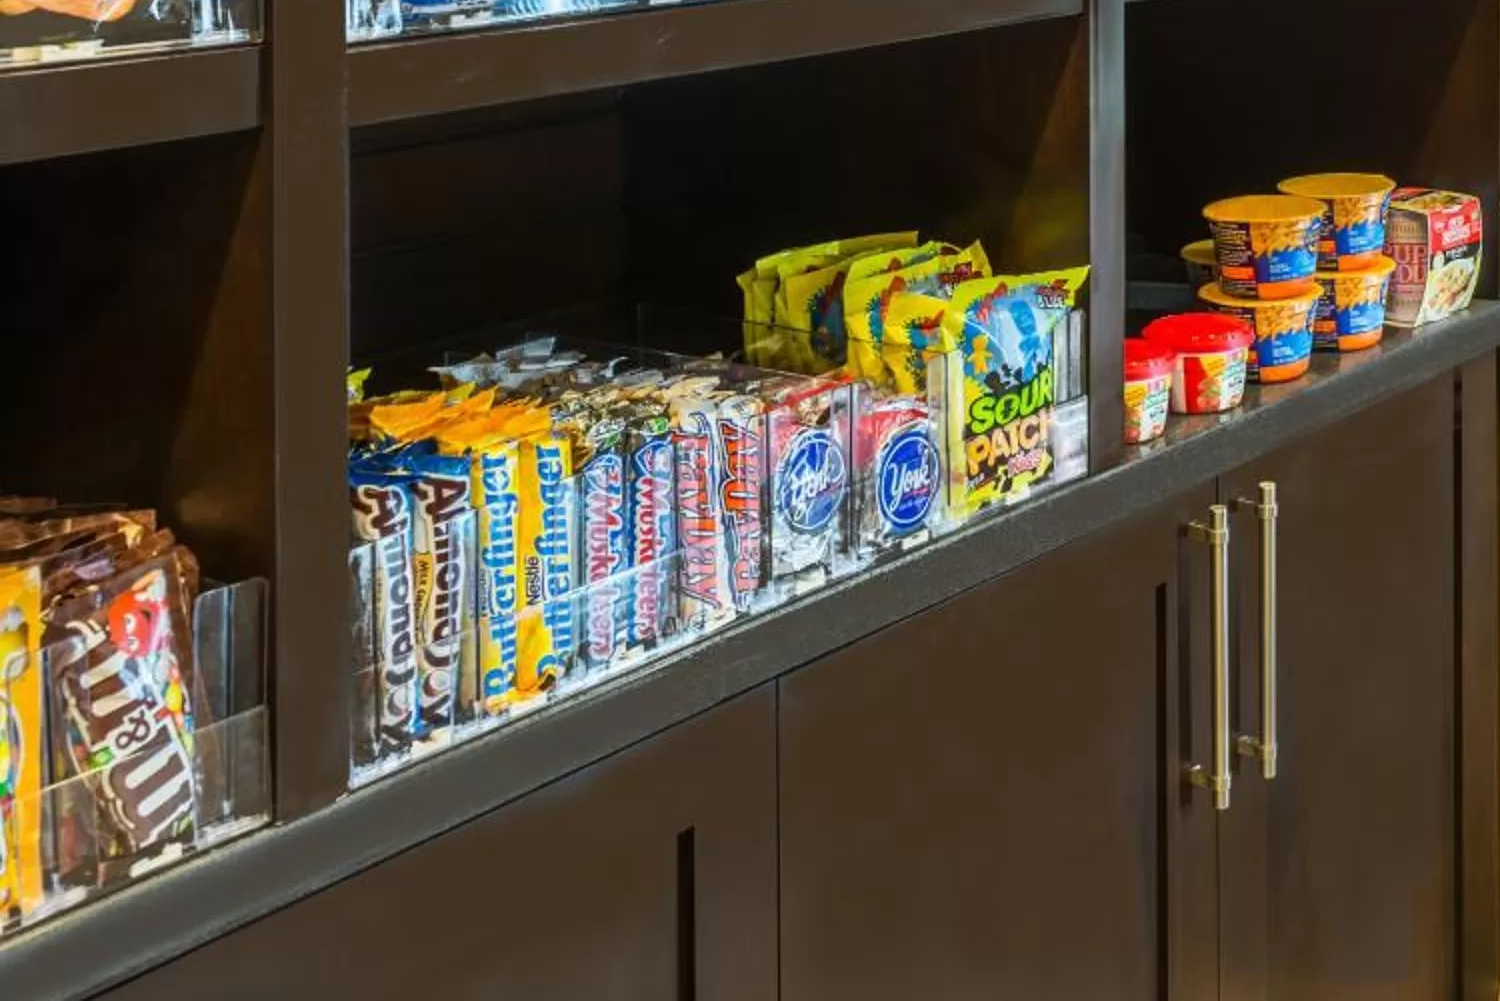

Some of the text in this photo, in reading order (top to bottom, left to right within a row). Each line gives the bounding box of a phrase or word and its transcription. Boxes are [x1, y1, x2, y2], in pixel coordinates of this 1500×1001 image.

[887, 459, 932, 509] York
[970, 366, 1053, 435] SOUR
[355, 486, 415, 666] Almond
[411, 476, 468, 644] Almond
[480, 448, 520, 699] Butterfinger
